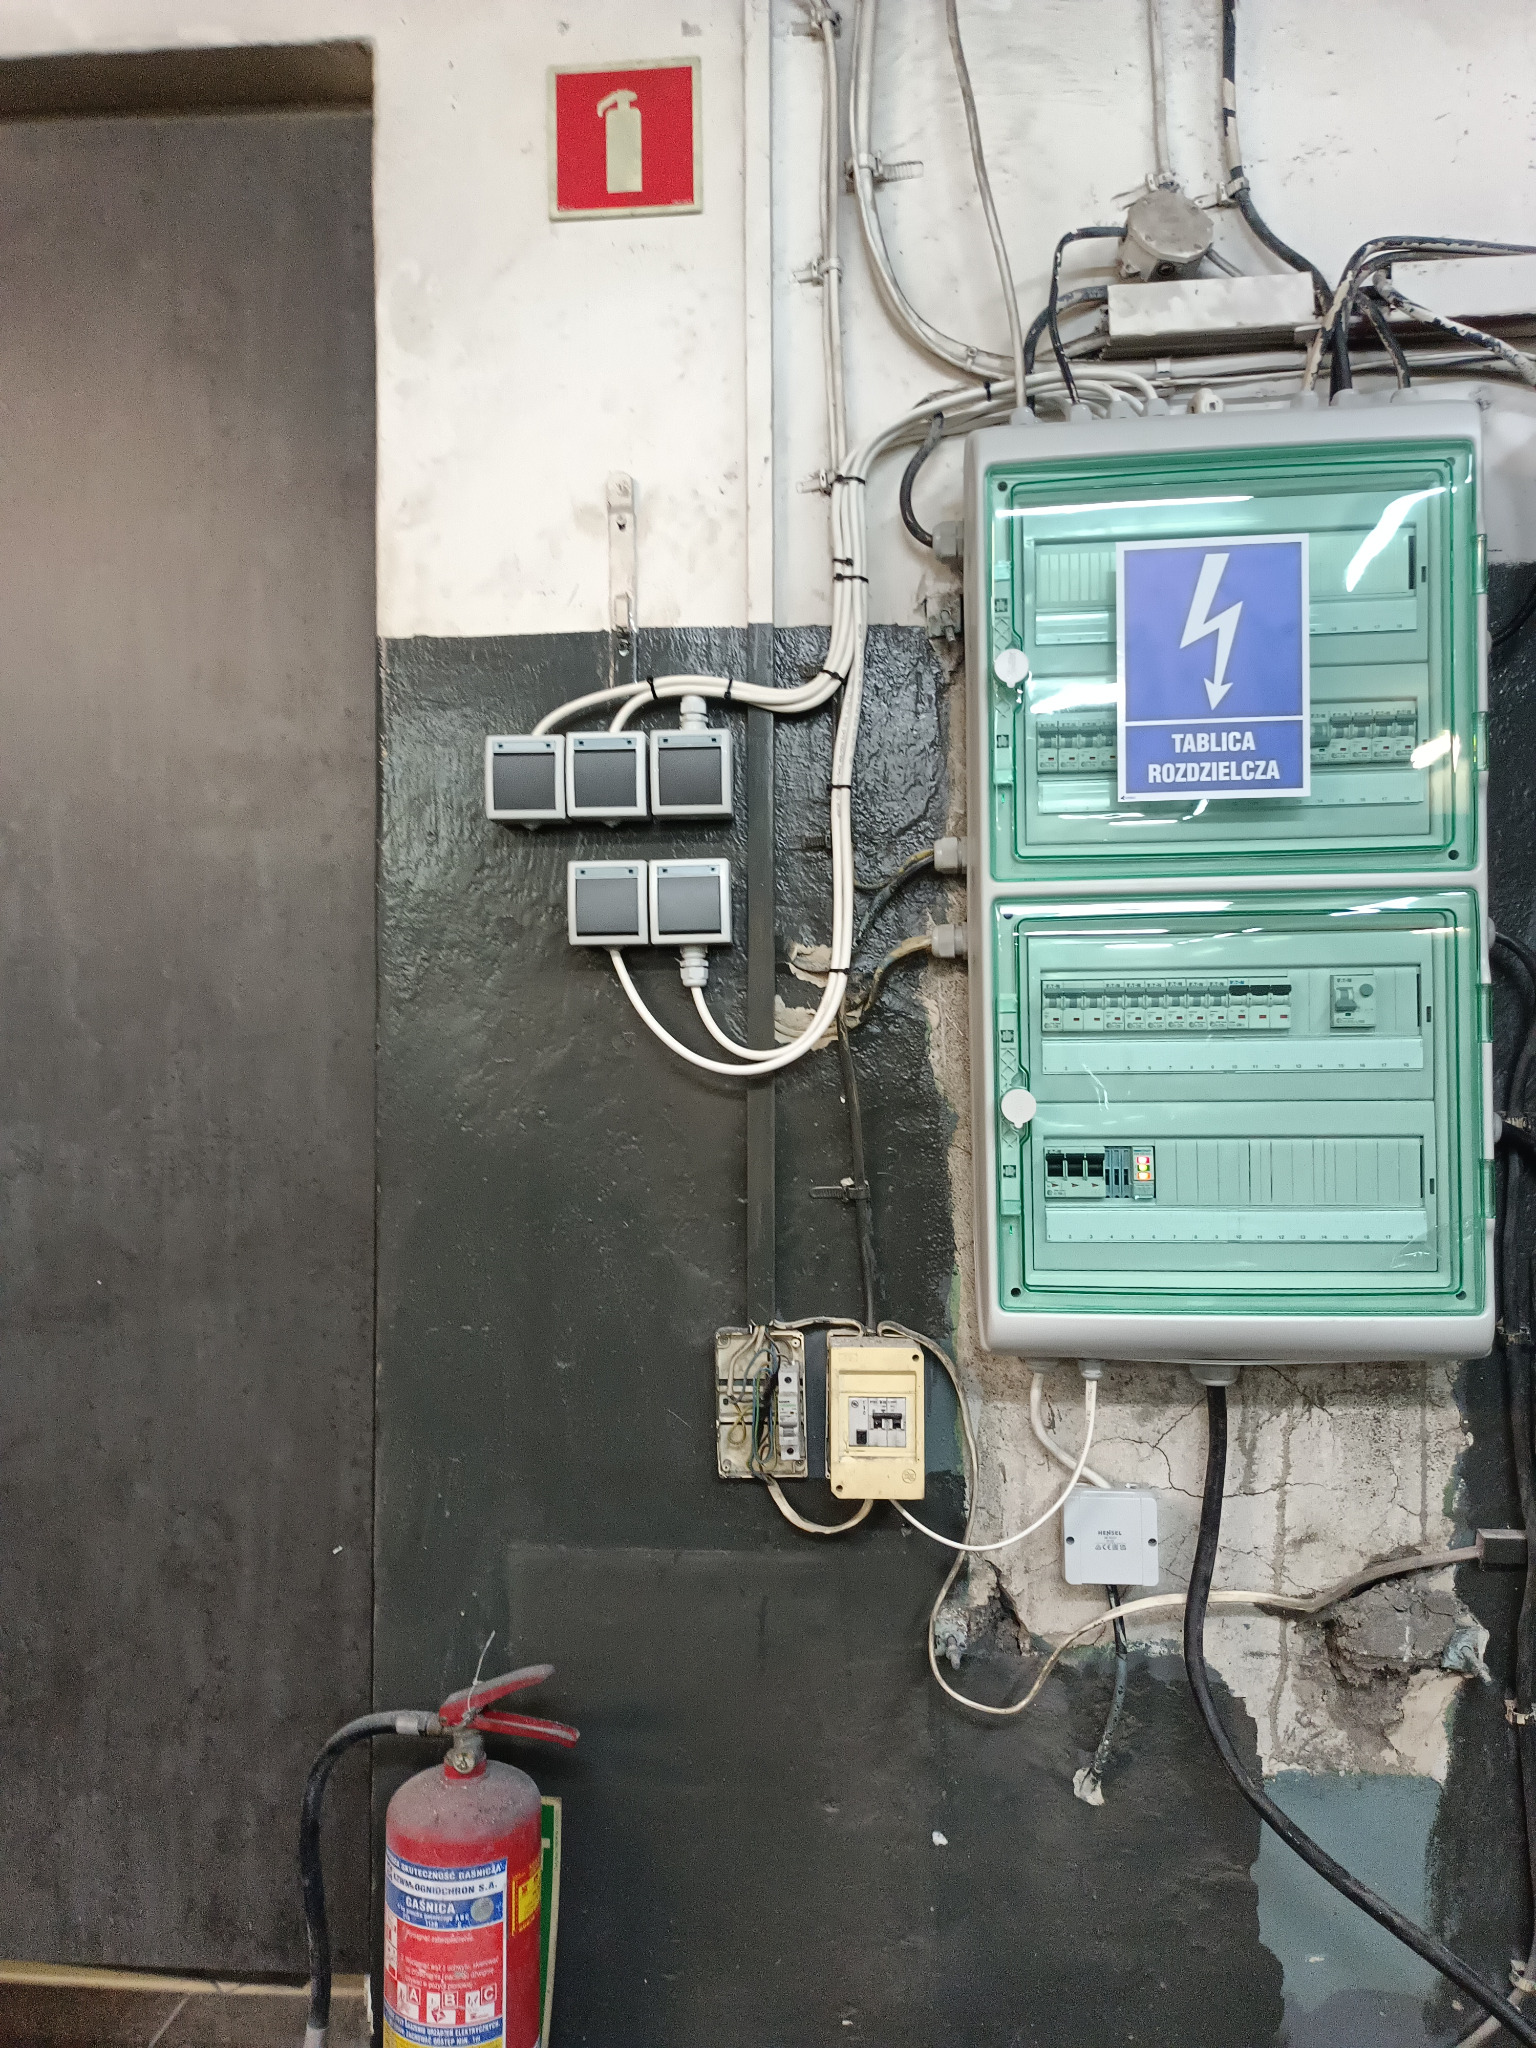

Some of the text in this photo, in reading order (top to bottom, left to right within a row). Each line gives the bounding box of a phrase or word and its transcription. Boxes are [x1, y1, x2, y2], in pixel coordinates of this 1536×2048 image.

[1172, 731, 1256, 754] TABLICA
[1148, 761, 1280, 784] ROZDZIELCZA
[405, 1896, 456, 1914] GAŚNICA
[410, 1991, 418, 2002] A
[445, 1994, 455, 2006] B
[484, 1987, 494, 2000] C
